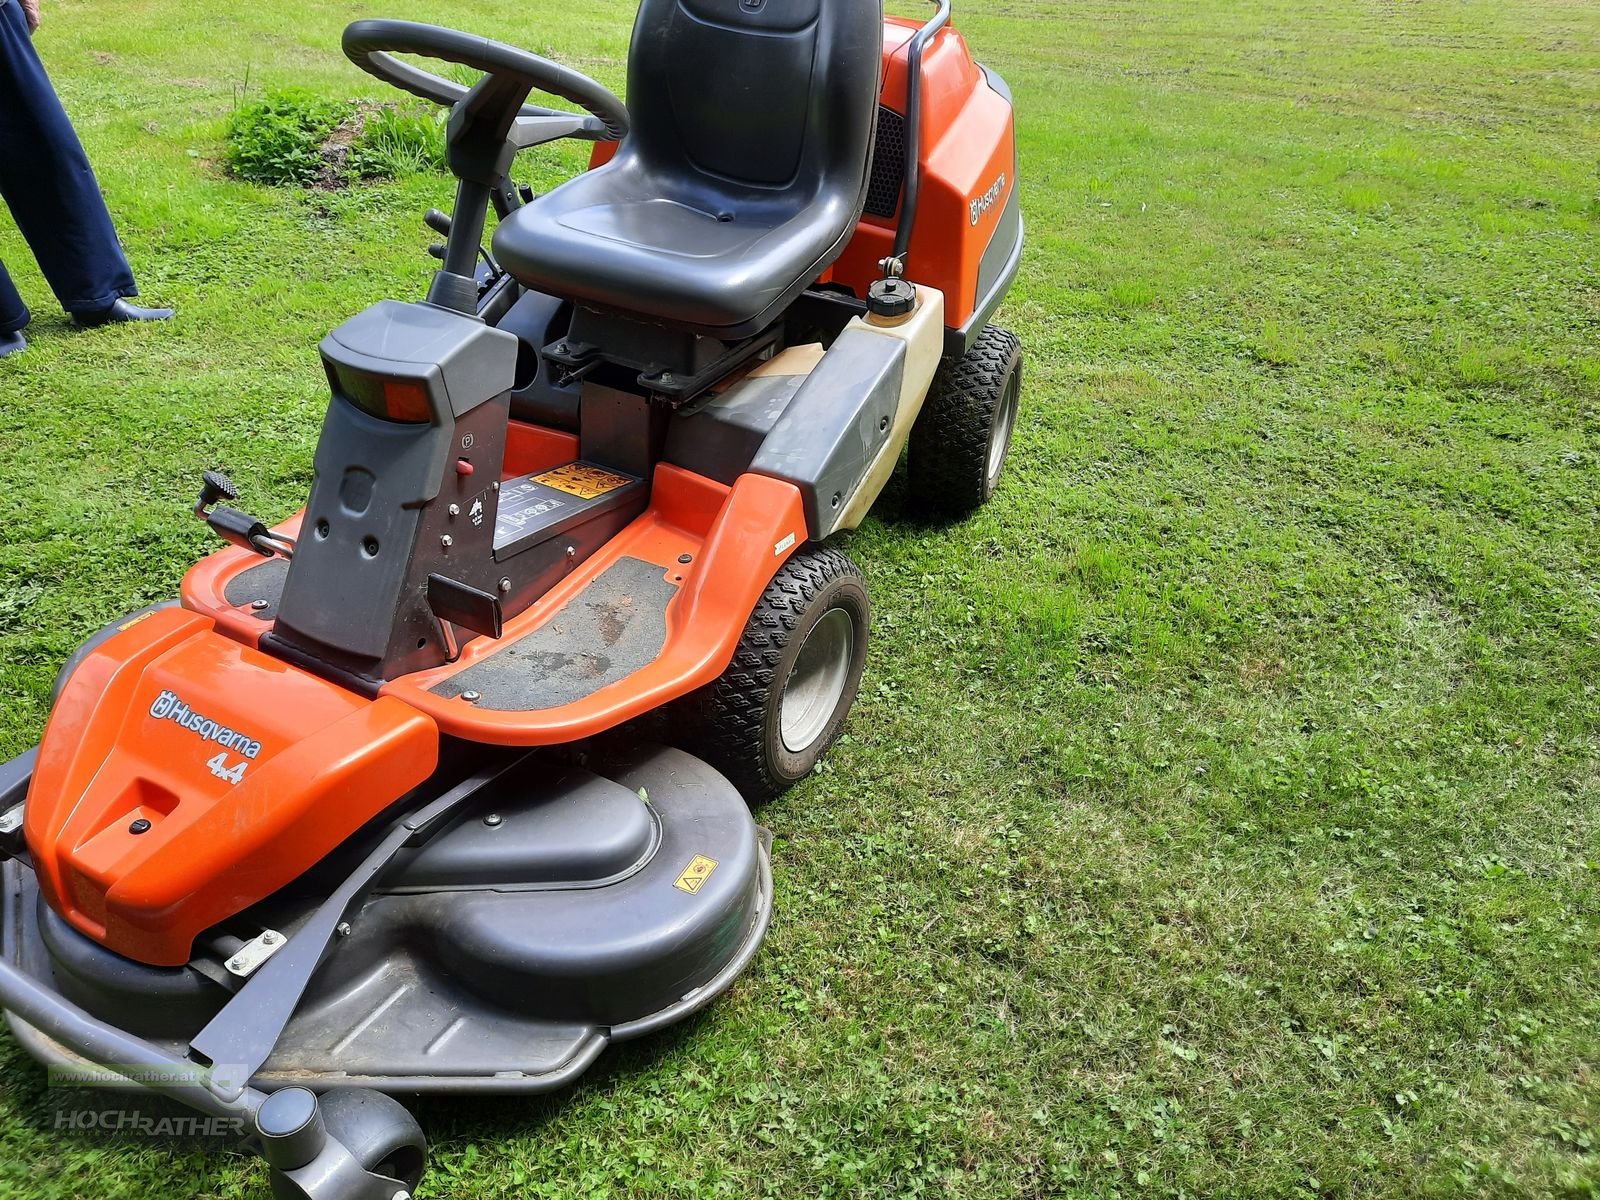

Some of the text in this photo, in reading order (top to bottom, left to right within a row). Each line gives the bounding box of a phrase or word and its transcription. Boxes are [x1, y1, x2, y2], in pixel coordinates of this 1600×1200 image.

[978, 173, 1005, 215] Husqvarna
[167, 701, 262, 759] Husqvarna
[206, 752, 248, 785] 4x4
